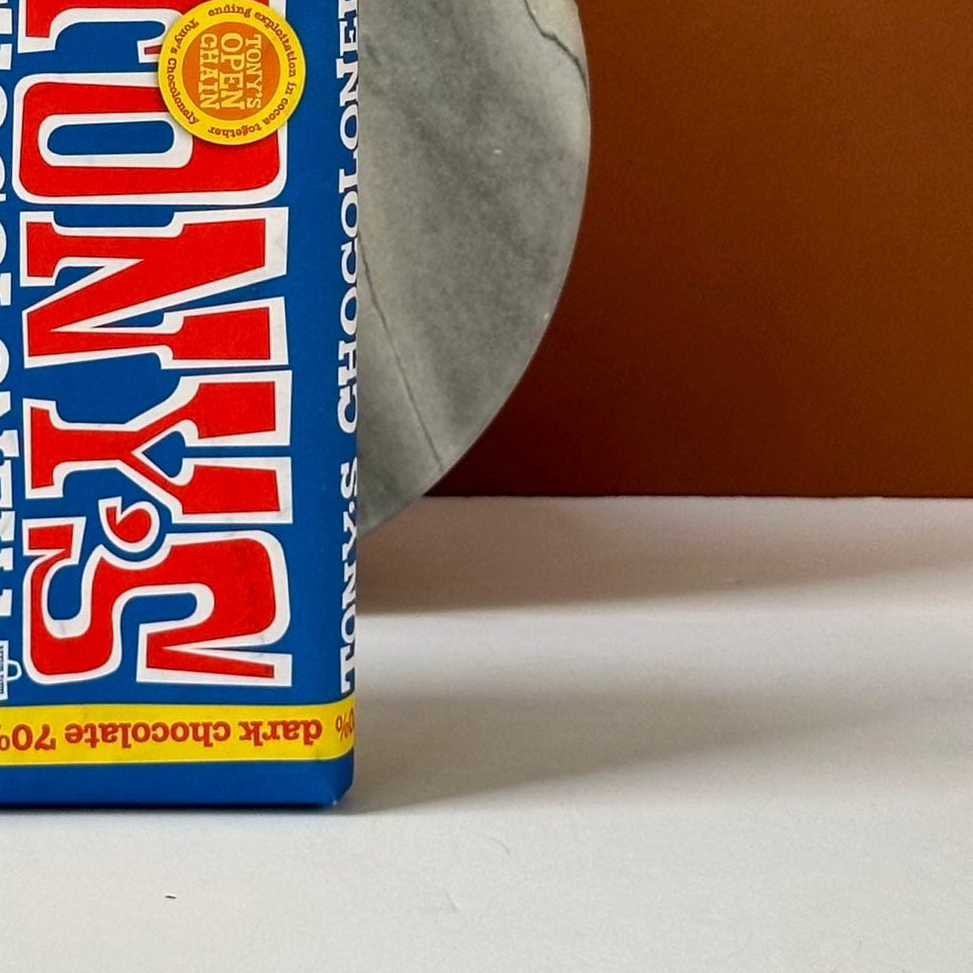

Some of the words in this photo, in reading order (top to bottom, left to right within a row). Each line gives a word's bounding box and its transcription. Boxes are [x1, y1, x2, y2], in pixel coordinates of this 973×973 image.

[208, 4, 253, 19] ending
[171, 18, 200, 54] Tony's
[254, 11, 297, 78] exploitation
[198, 32, 220, 110] CHAIN
[219, 32, 245, 110] OPEN
[245, 33, 263, 109] TONY'S
[167, 58, 200, 125] Chocolonely
[285, 82, 297, 95] in
[262, 97, 288, 125] cocoa
[207, 123, 262, 138] together
[64, 720, 231, 749] chocolate
[238, 719, 323, 746] dark
